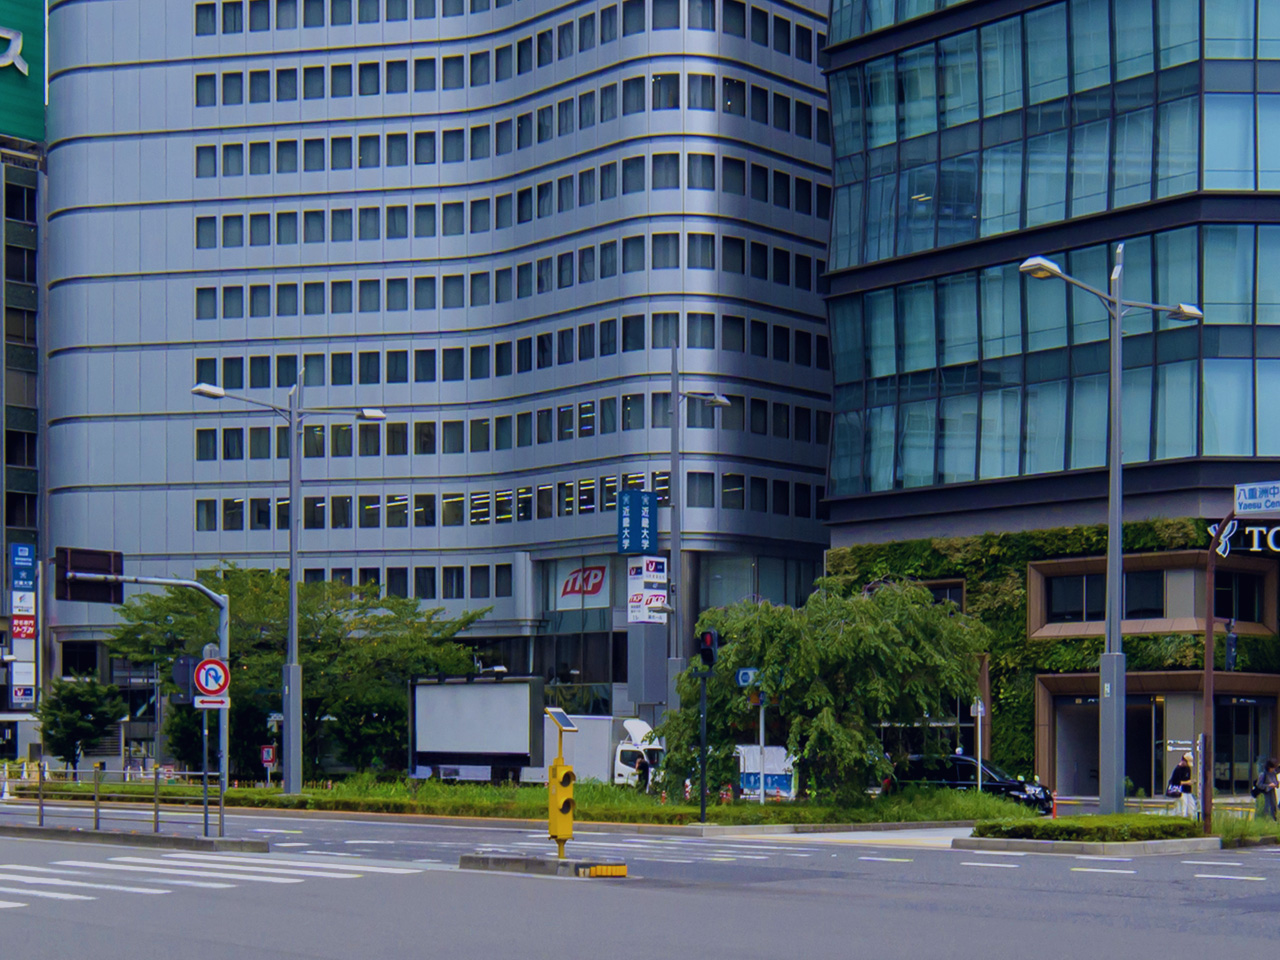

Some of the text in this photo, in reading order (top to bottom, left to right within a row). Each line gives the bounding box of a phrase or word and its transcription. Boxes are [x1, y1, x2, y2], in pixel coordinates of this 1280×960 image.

[1238, 501, 1262, 511] Yaesu
[622, 507, 630, 550] 近畿大学
[641, 507, 650, 550] 近畿大学
[563, 568, 605, 596] TKP
